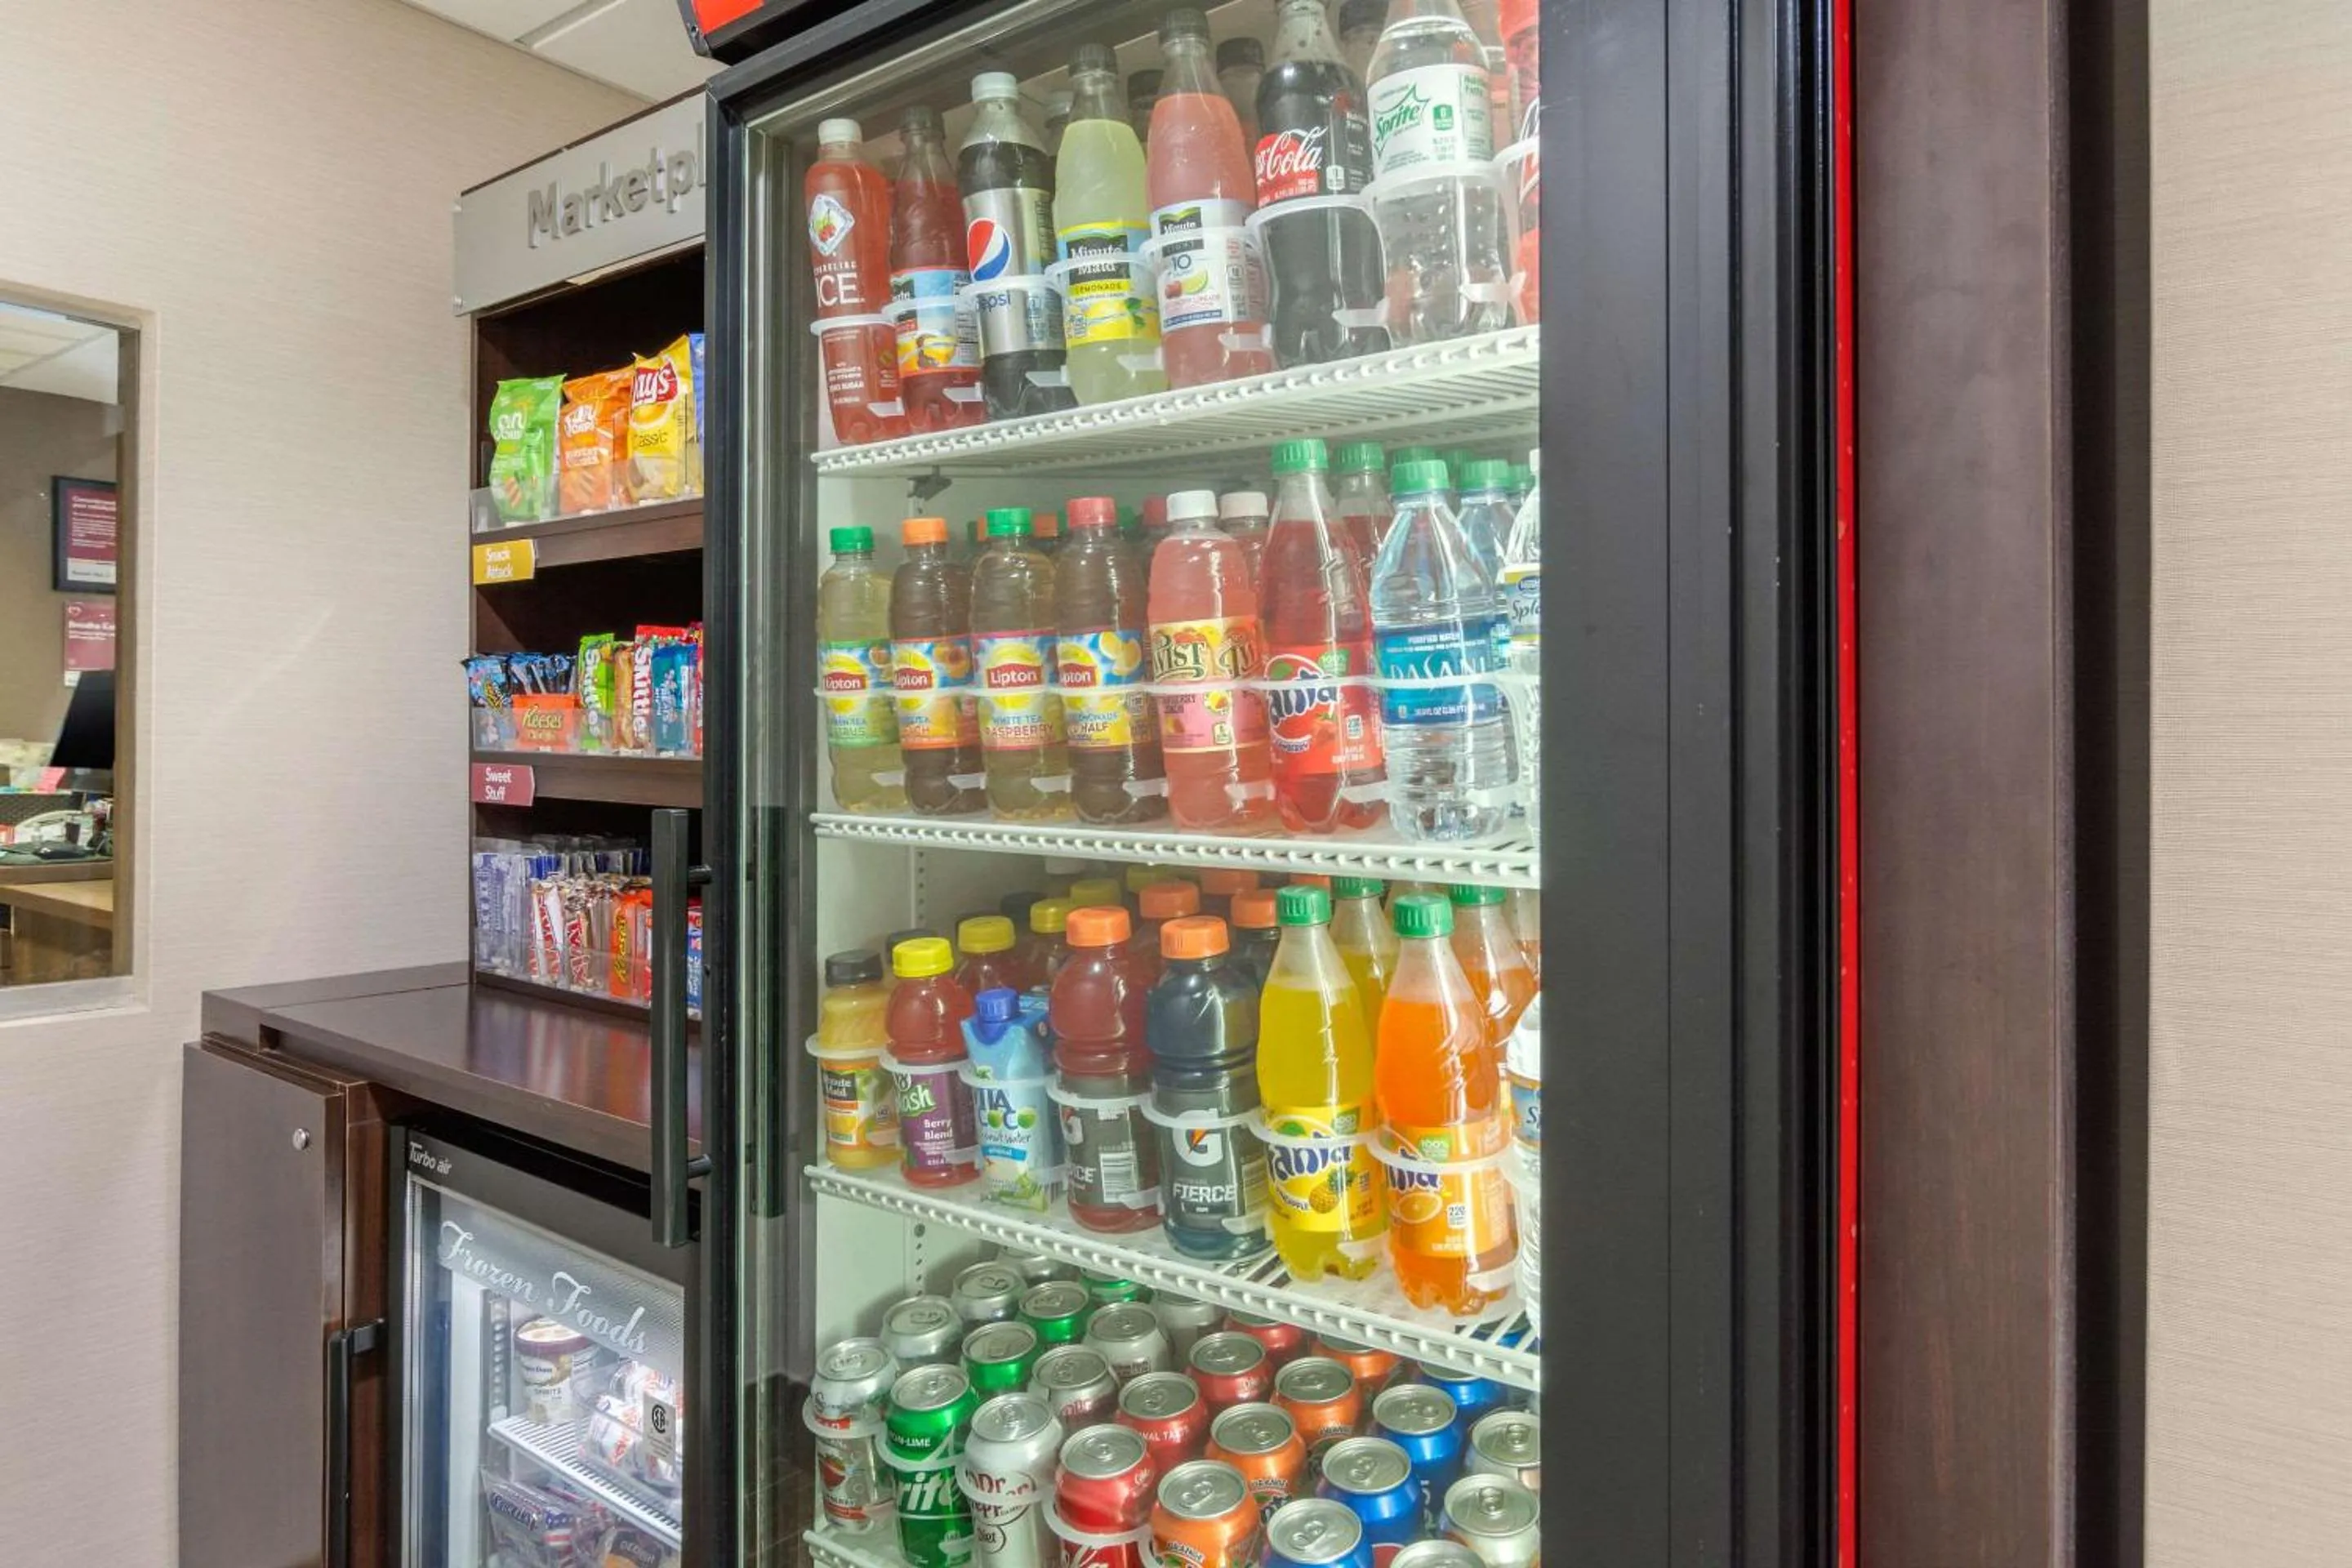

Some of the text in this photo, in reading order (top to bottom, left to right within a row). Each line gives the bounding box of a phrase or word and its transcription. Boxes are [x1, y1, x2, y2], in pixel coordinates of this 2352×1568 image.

[1375, 104, 1420, 143] Sprite
[1073, 281, 1122, 296] LEMONADE
[976, 289, 1012, 314] epsi
[825, 675, 861, 689] Lipton
[990, 670, 1037, 686] Lipton
[1062, 670, 1092, 685] pton
[485, 767, 513, 785] Sweet
[485, 784, 506, 801] Stuff
[924, 1118, 952, 1130] Berry
[924, 1129, 953, 1141] Blend
[409, 1141, 452, 1175] Turbo air
[1172, 1183, 1237, 1203] FIERCE
[440, 1220, 650, 1355] Frozen Foods
